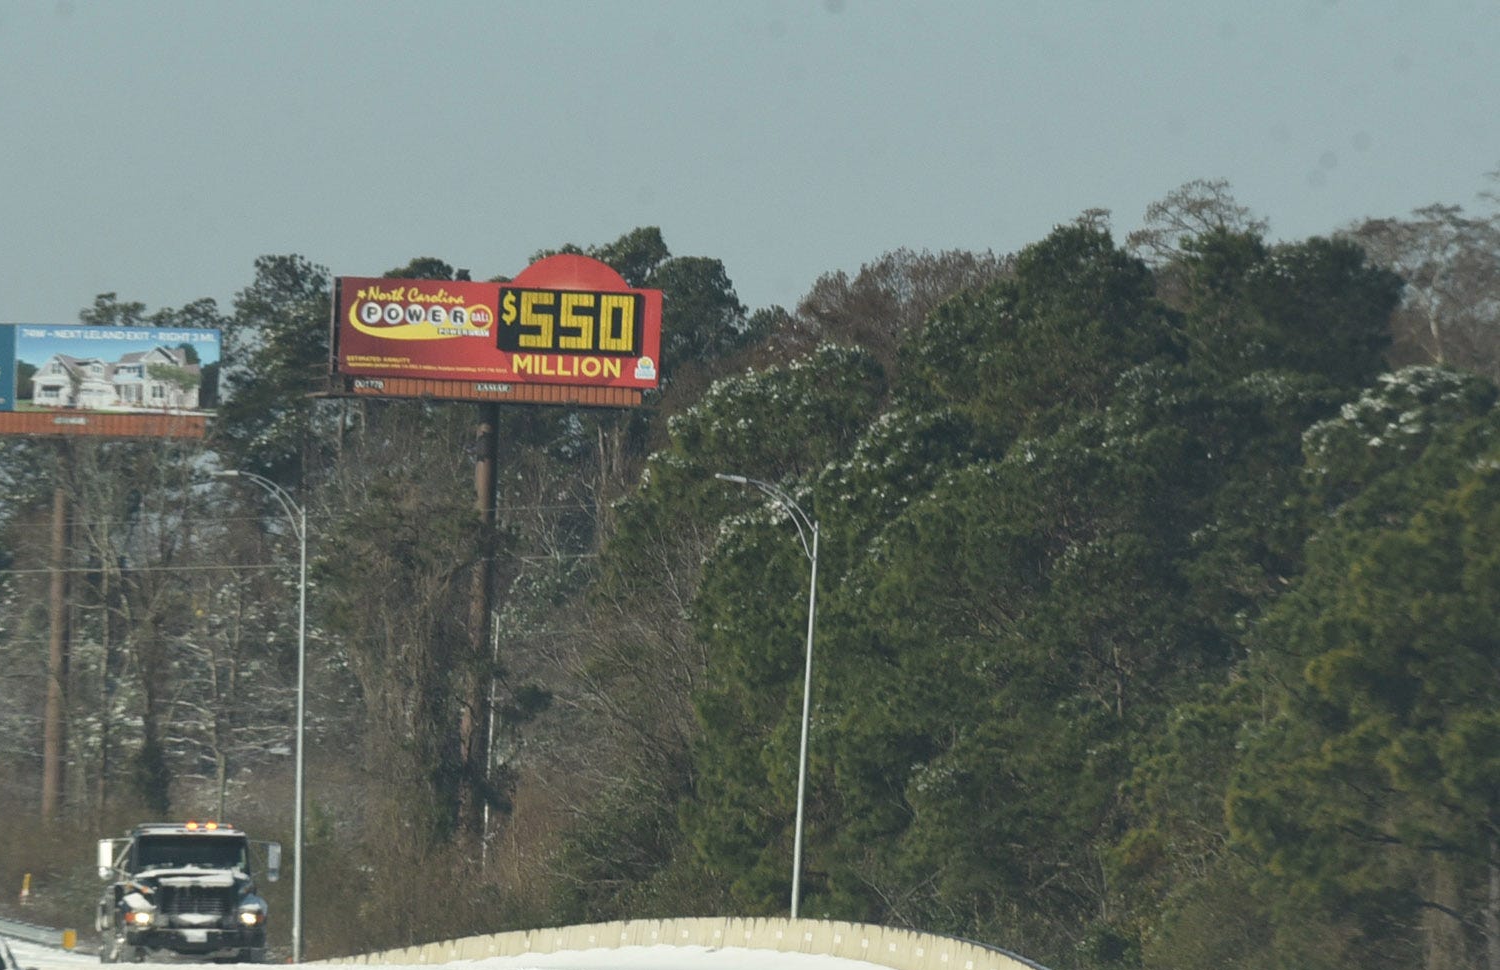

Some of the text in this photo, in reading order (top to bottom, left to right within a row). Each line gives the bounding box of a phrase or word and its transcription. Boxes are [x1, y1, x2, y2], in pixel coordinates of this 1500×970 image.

[367, 287, 465, 304] North Carolina
[502, 290, 635, 352] $550
[53, 330, 82, 339] NEXT
[83, 331, 126, 340] LELAND
[127, 332, 150, 340] EXIT
[158, 333, 190, 342] RIGHT
[512, 354, 622, 378] MILLION
